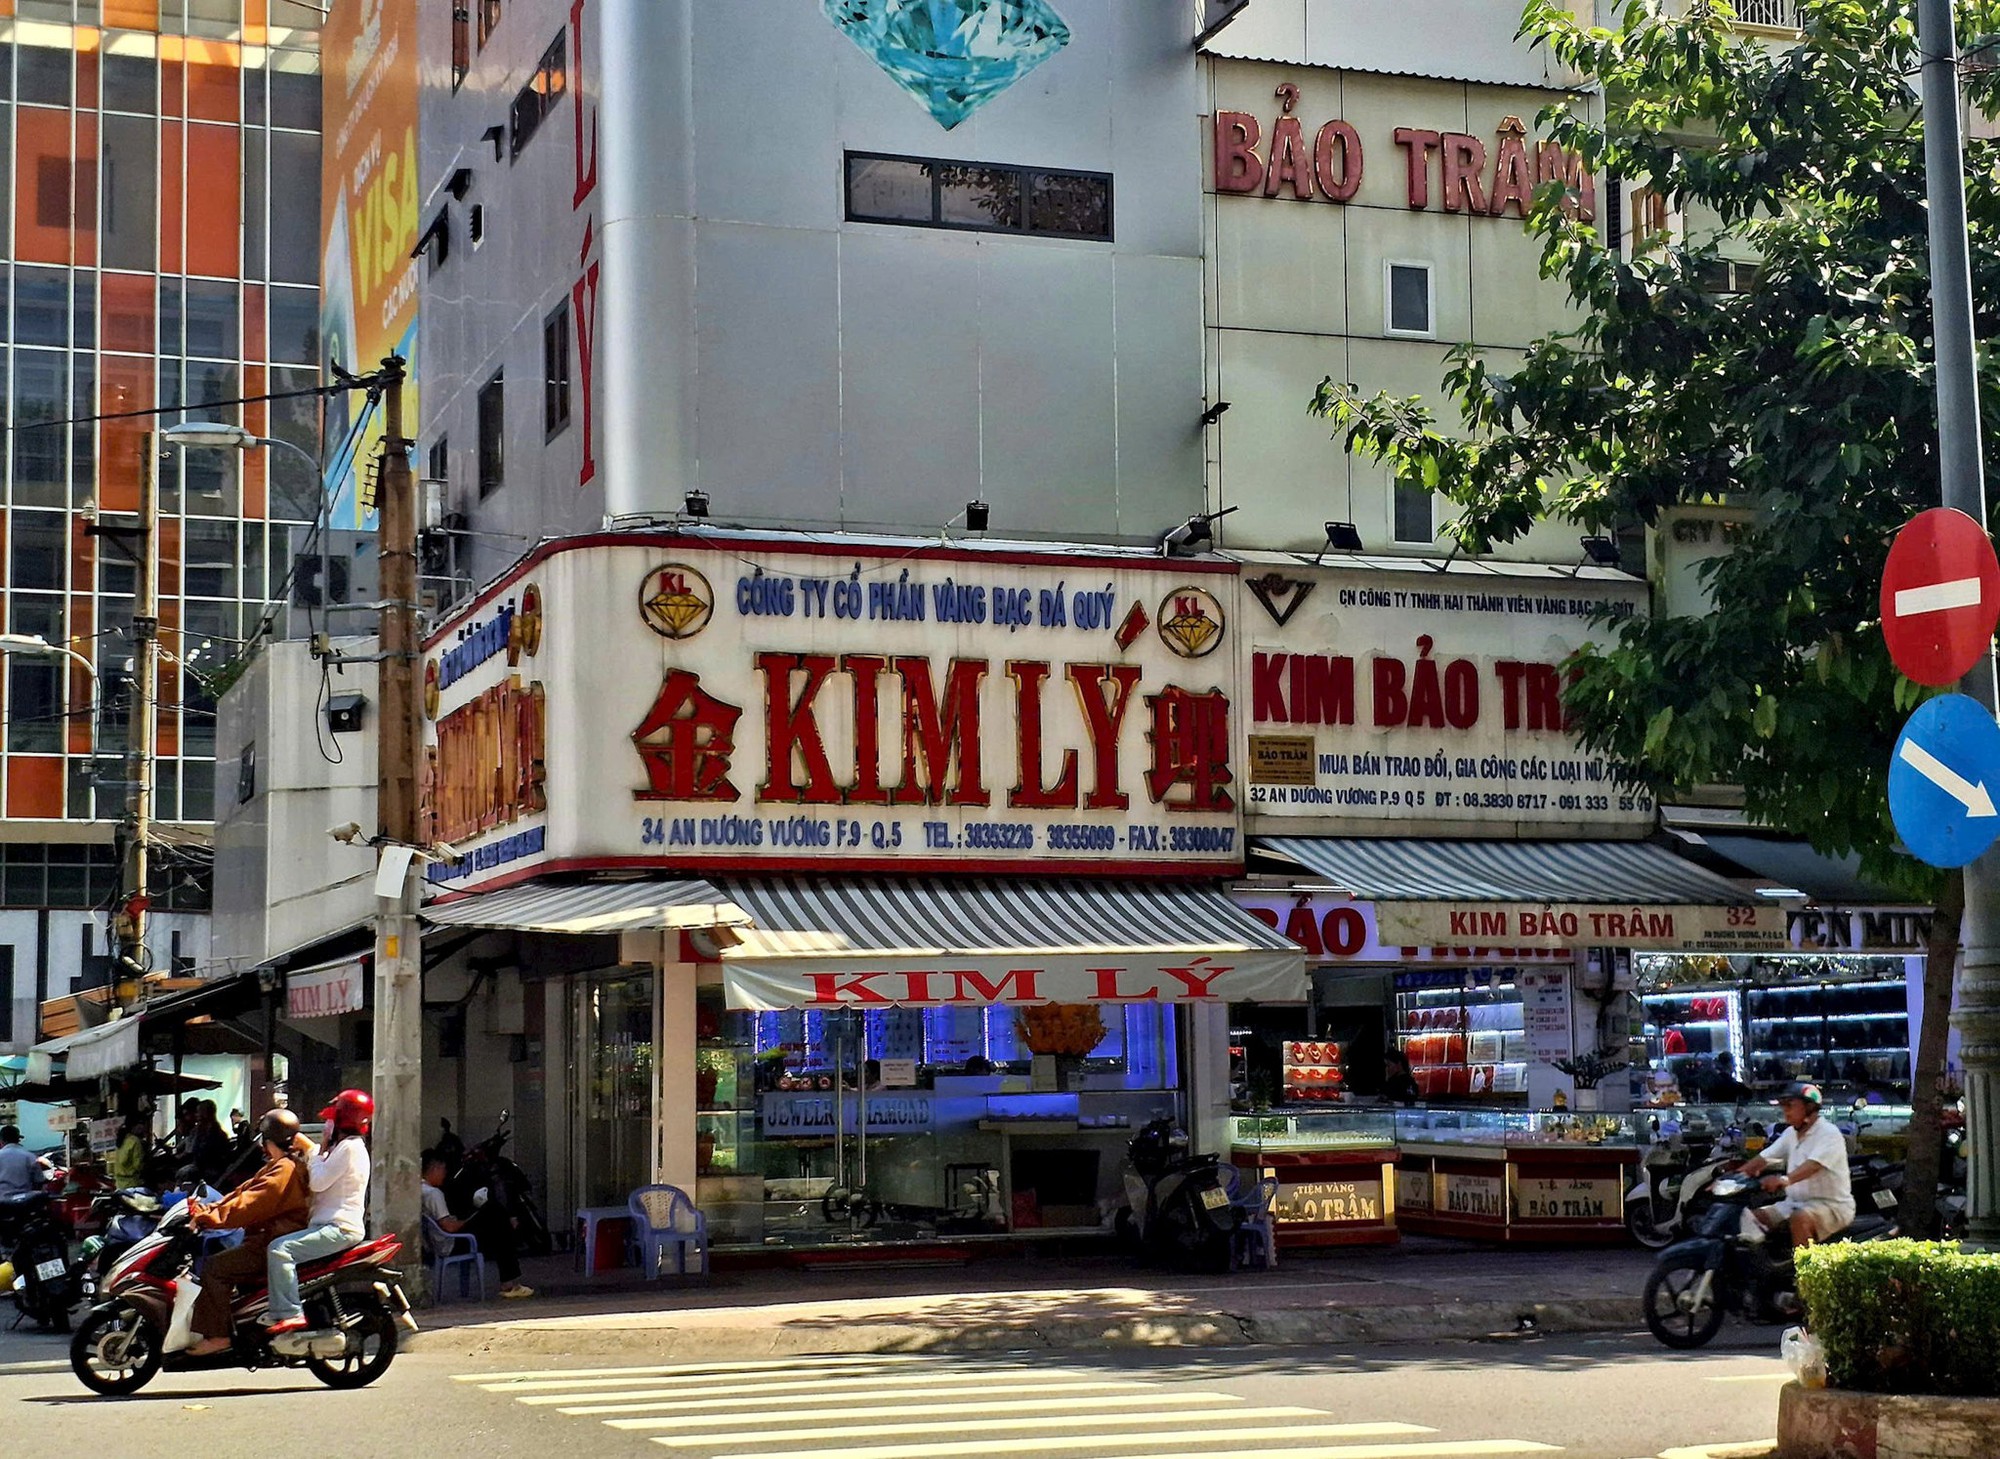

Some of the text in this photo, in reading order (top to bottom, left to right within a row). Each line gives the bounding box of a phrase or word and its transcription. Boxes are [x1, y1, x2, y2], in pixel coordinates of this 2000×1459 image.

[1215, 83, 1596, 222] BẢO TRÂM
[354, 124, 419, 308] VISA
[660, 572, 692, 594] KL
[737, 561, 1115, 632] CÔNG TY CỔ PHẦN VÀNG BẠC ĐÁ QUÝ
[1174, 596, 1205, 617] KL
[1339, 589, 1356, 608] CN
[1359, 588, 1391, 608] CÔNG
[1394, 591, 1407, 609] TY
[1410, 593, 1440, 611] TNHH
[1444, 594, 1463, 611] HAI
[1466, 592, 1503, 613] THÀNH
[1507, 595, 1532, 614] VIÊN
[1535, 595, 1566, 615] VÀNG
[1569, 599, 1592, 619] BẠC
[1252, 651, 1355, 726] KIM
[1373, 633, 1479, 730] BẢO
[753, 651, 991, 807] KIM
[1005, 600, 1150, 811] LÝ
[630, 667, 743, 803] 金
[1142, 684, 1236, 813] 理
[1258, 747, 1278, 760] BẢO
[1319, 753, 1348, 775] MUA
[1352, 751, 1380, 776] BÁN
[1385, 756, 1420, 777] TRAO
[1424, 748, 1452, 781] ĐỔI,
[1456, 757, 1477, 778] GIA
[1480, 755, 1516, 780] CÔNG
[1520, 756, 1547, 780] CÁC
[1551, 760, 1581, 785] LOẠI
[1250, 787, 1266, 803] 32
[1269, 788, 1287, 803] AN
[1380, 791, 1400, 806] P.9
[1463, 792, 1513, 809] 08.3830
[1559, 795, 1582, 810] 091
[1585, 796, 1608, 811] 333
[1618, 796, 1635, 811] 55
[642, 817, 664, 846] 34
[669, 817, 696, 847] AN
[701, 813, 763, 848] DƯƠNG
[768, 815, 830, 848] VƯƠNG
[837, 819, 860, 848] F.9
[964, 822, 1034, 850] 38353226
[1450, 902, 1675, 938] KIM BẢO TRÂM
[1727, 905, 1757, 926] 32
[1859, 910, 1935, 949] MIN
[289, 969, 350, 1014] KIM LÝ
[802, 957, 1236, 1004] KIM LÝ
[768, 1098, 836, 1127] JEWELR
[1297, 1182, 1355, 1195] TIỆM VÀNG
[1321, 1193, 1375, 1220] TRÂM
[1448, 1183, 1469, 1211] BẢO
[1529, 1194, 1604, 1217] BẢO TRÂM
